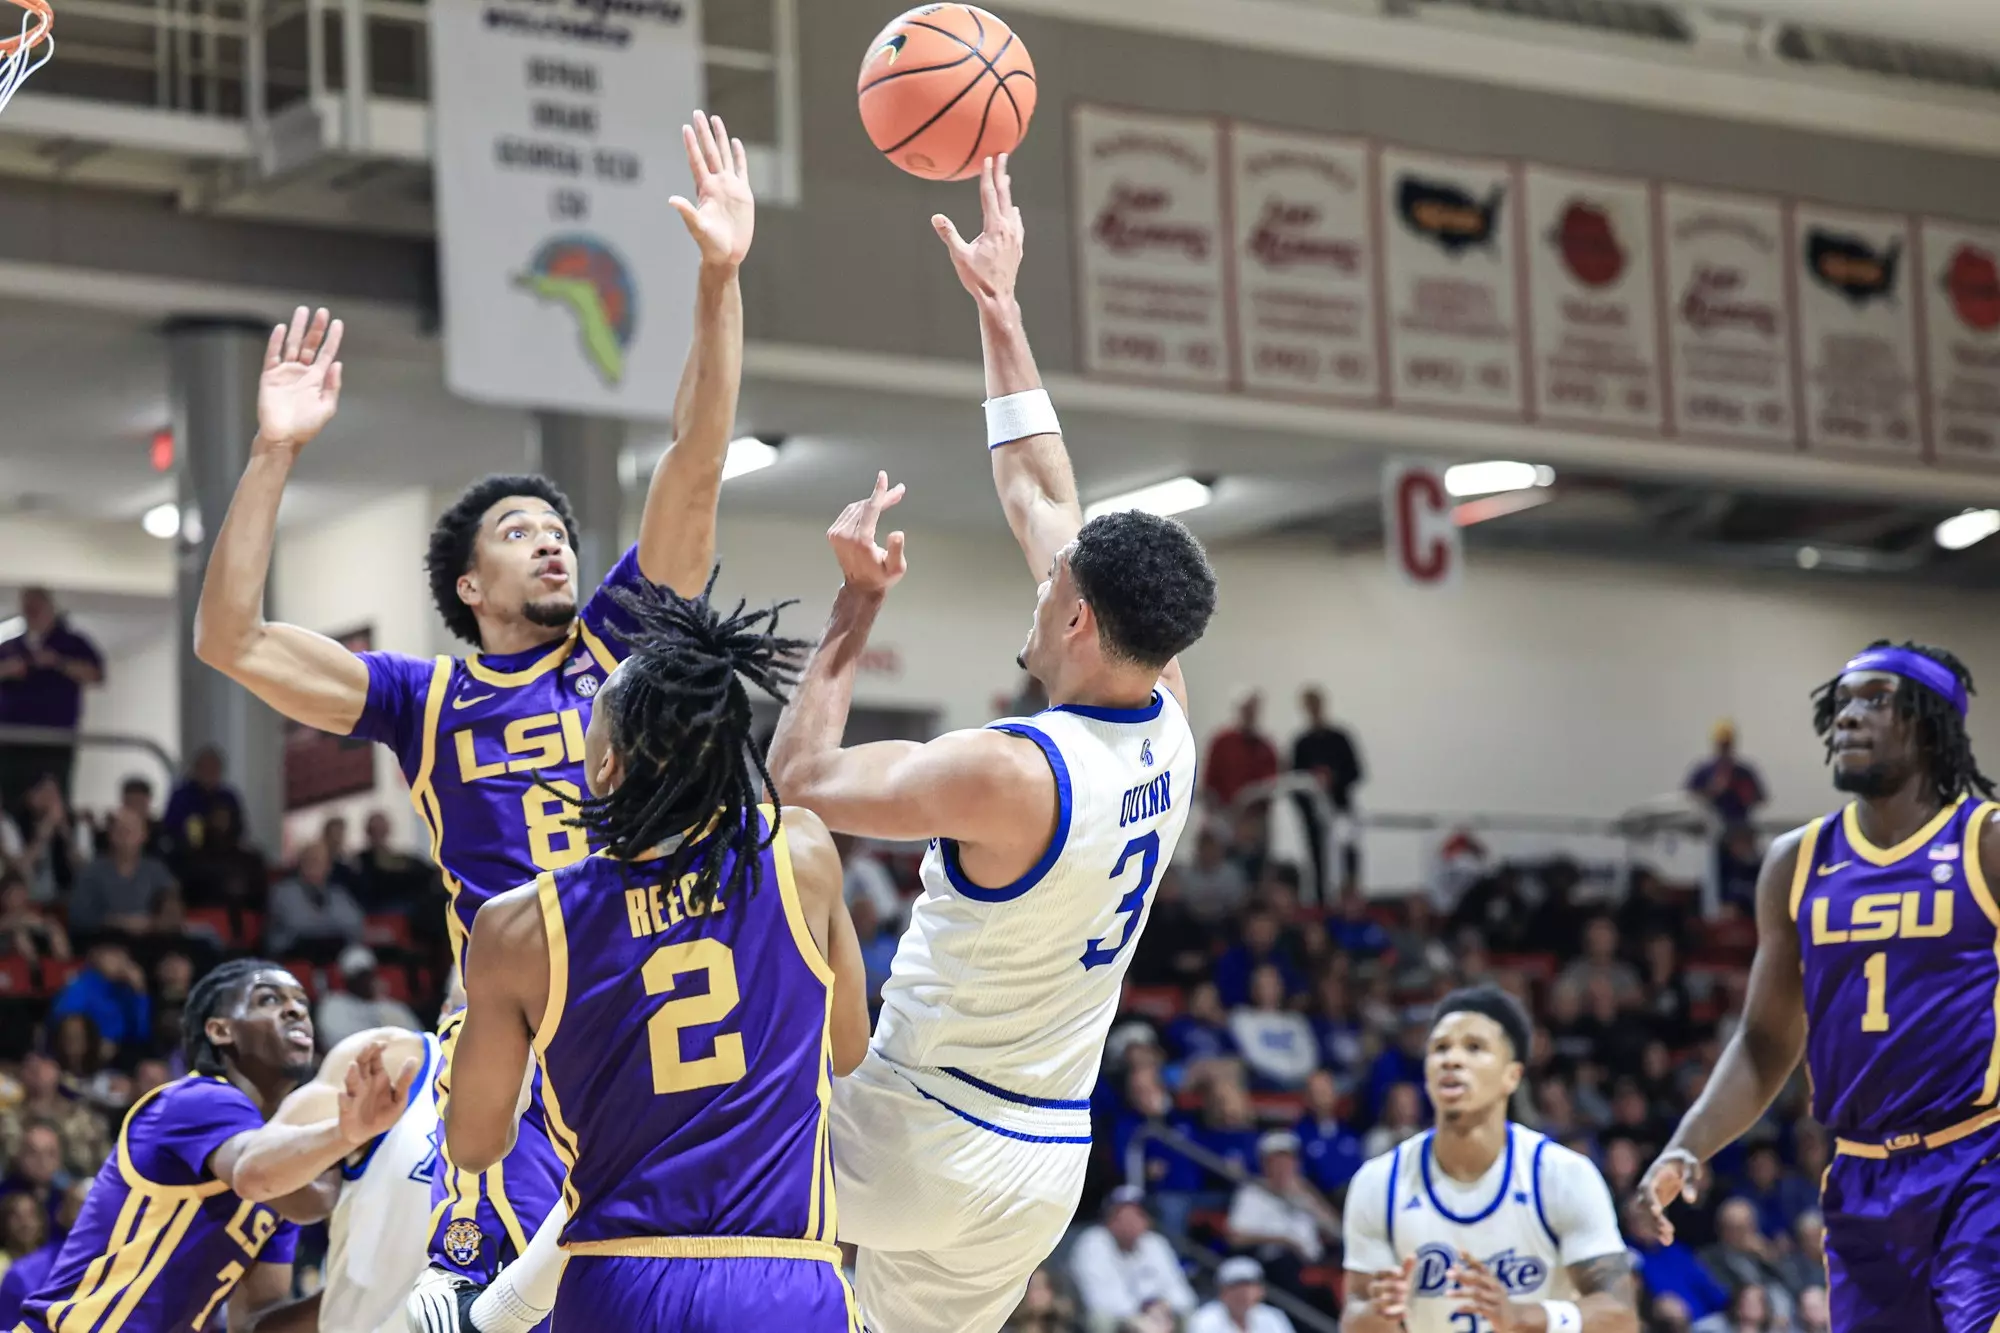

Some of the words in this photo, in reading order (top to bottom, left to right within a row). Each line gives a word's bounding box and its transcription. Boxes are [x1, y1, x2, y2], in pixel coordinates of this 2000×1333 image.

[1397, 469, 1450, 583] C
[522, 780, 590, 871] 8
[1120, 770, 1171, 828] QUINN
[1079, 829, 1160, 972] 3
[1811, 889, 1954, 945] LSU
[641, 937, 747, 1095] 2
[1861, 952, 1889, 1032] 1
[1885, 1132, 1920, 1150] LSU
[1418, 1248, 1540, 1292] Dke
